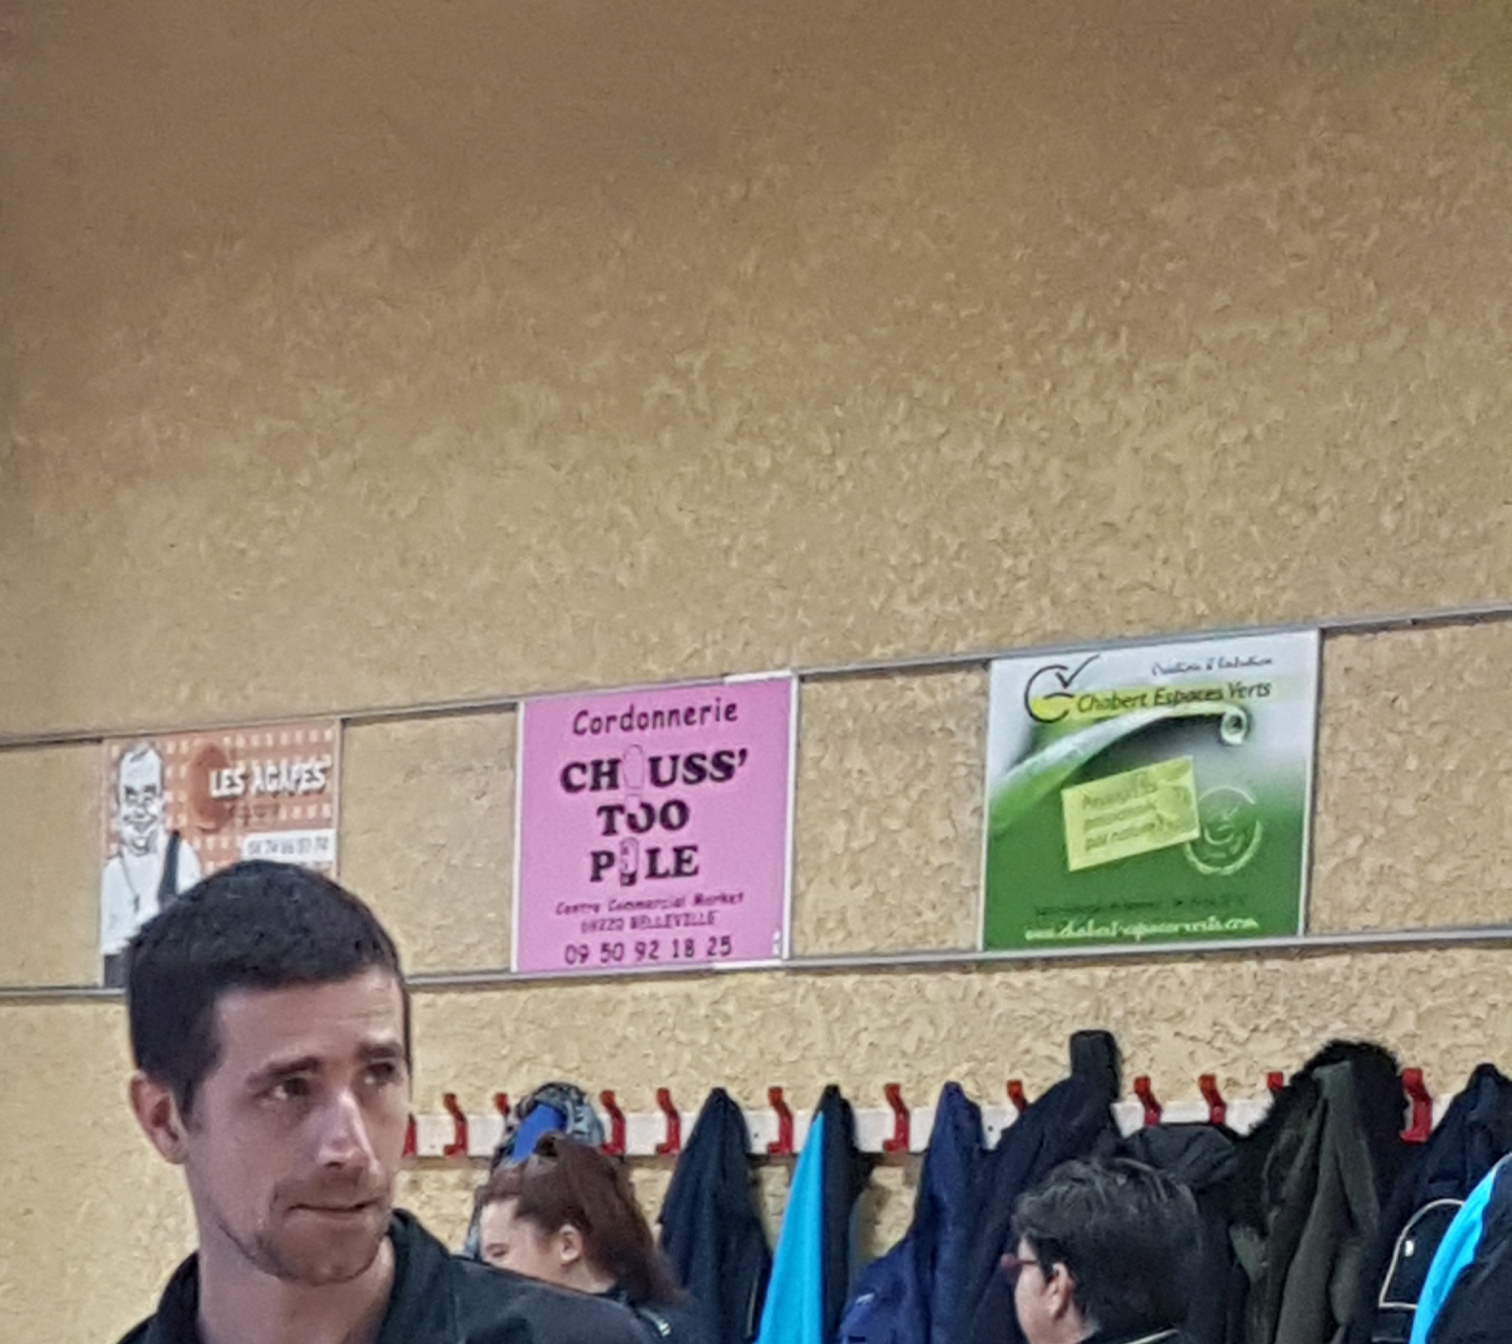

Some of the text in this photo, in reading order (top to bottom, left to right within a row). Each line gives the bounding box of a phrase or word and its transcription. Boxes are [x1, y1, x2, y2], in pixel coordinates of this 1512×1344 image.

[1154, 685, 1224, 707] Espaces
[1228, 680, 1273, 699] Verts
[572, 697, 739, 736] Cordonnerie
[209, 768, 247, 799] LES
[564, 935, 733, 965] 09 50 92 18 25
